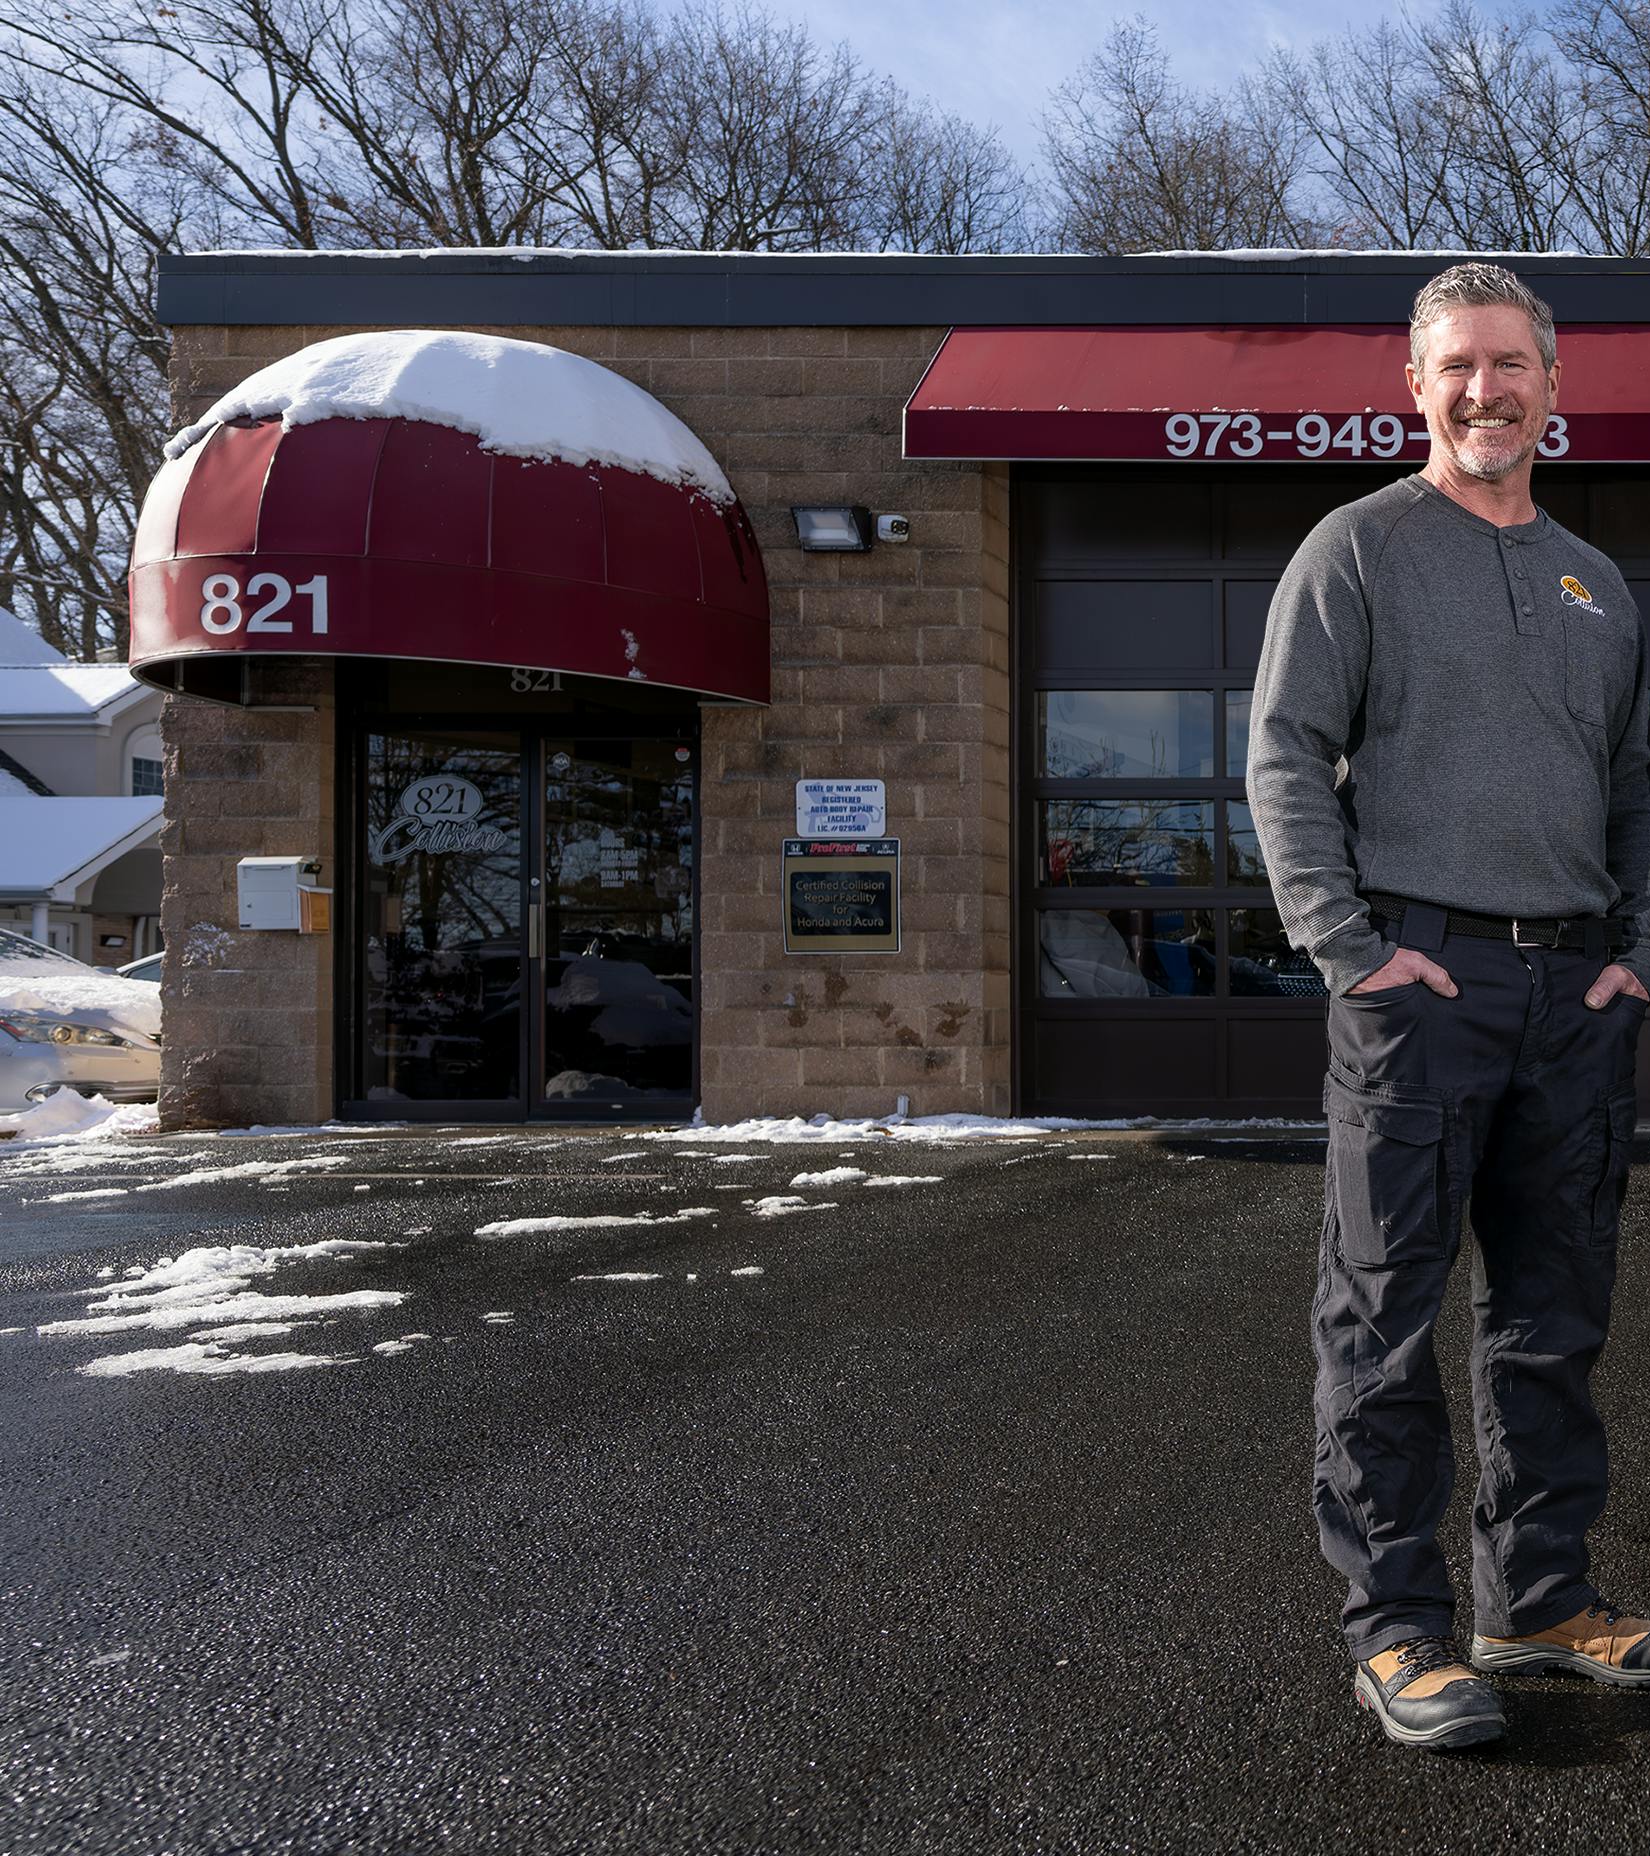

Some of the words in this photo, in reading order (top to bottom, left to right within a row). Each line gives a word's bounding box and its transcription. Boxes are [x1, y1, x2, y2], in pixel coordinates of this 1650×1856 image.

[1165, 413, 1571, 458] 973-949-3
[201, 572, 328, 635] 821
[510, 669, 565, 693] 821
[414, 783, 469, 815] 821
[827, 815, 857, 823] FACILITY
[374, 815, 507, 863] Collision
[795, 880, 839, 890] Certified
[841, 880, 885, 890] Collision
[804, 893, 837, 904] Repair
[839, 892, 876, 904] Facility
[832, 905, 848, 914] for
[797, 918, 830, 927] Honda
[832, 917, 852, 927] and
[854, 917, 884, 927] Acura
